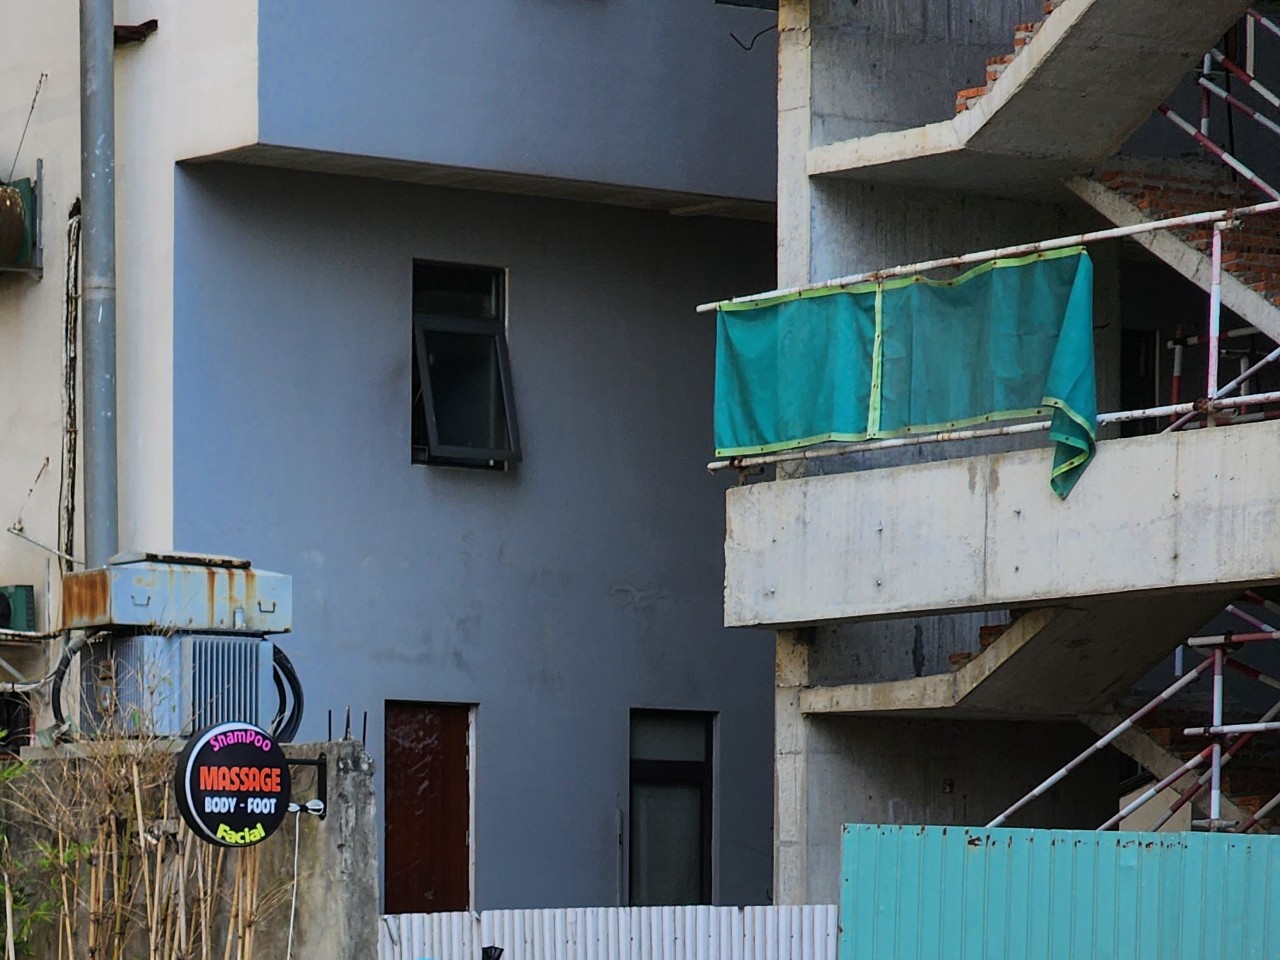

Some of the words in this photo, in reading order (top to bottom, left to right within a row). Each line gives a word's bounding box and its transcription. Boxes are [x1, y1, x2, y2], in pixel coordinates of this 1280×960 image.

[200, 766, 281, 792] MASSAGE
[204, 797, 237, 813] BODY
[247, 797, 277, 814] FOOT
[216, 823, 266, 844] Facial
